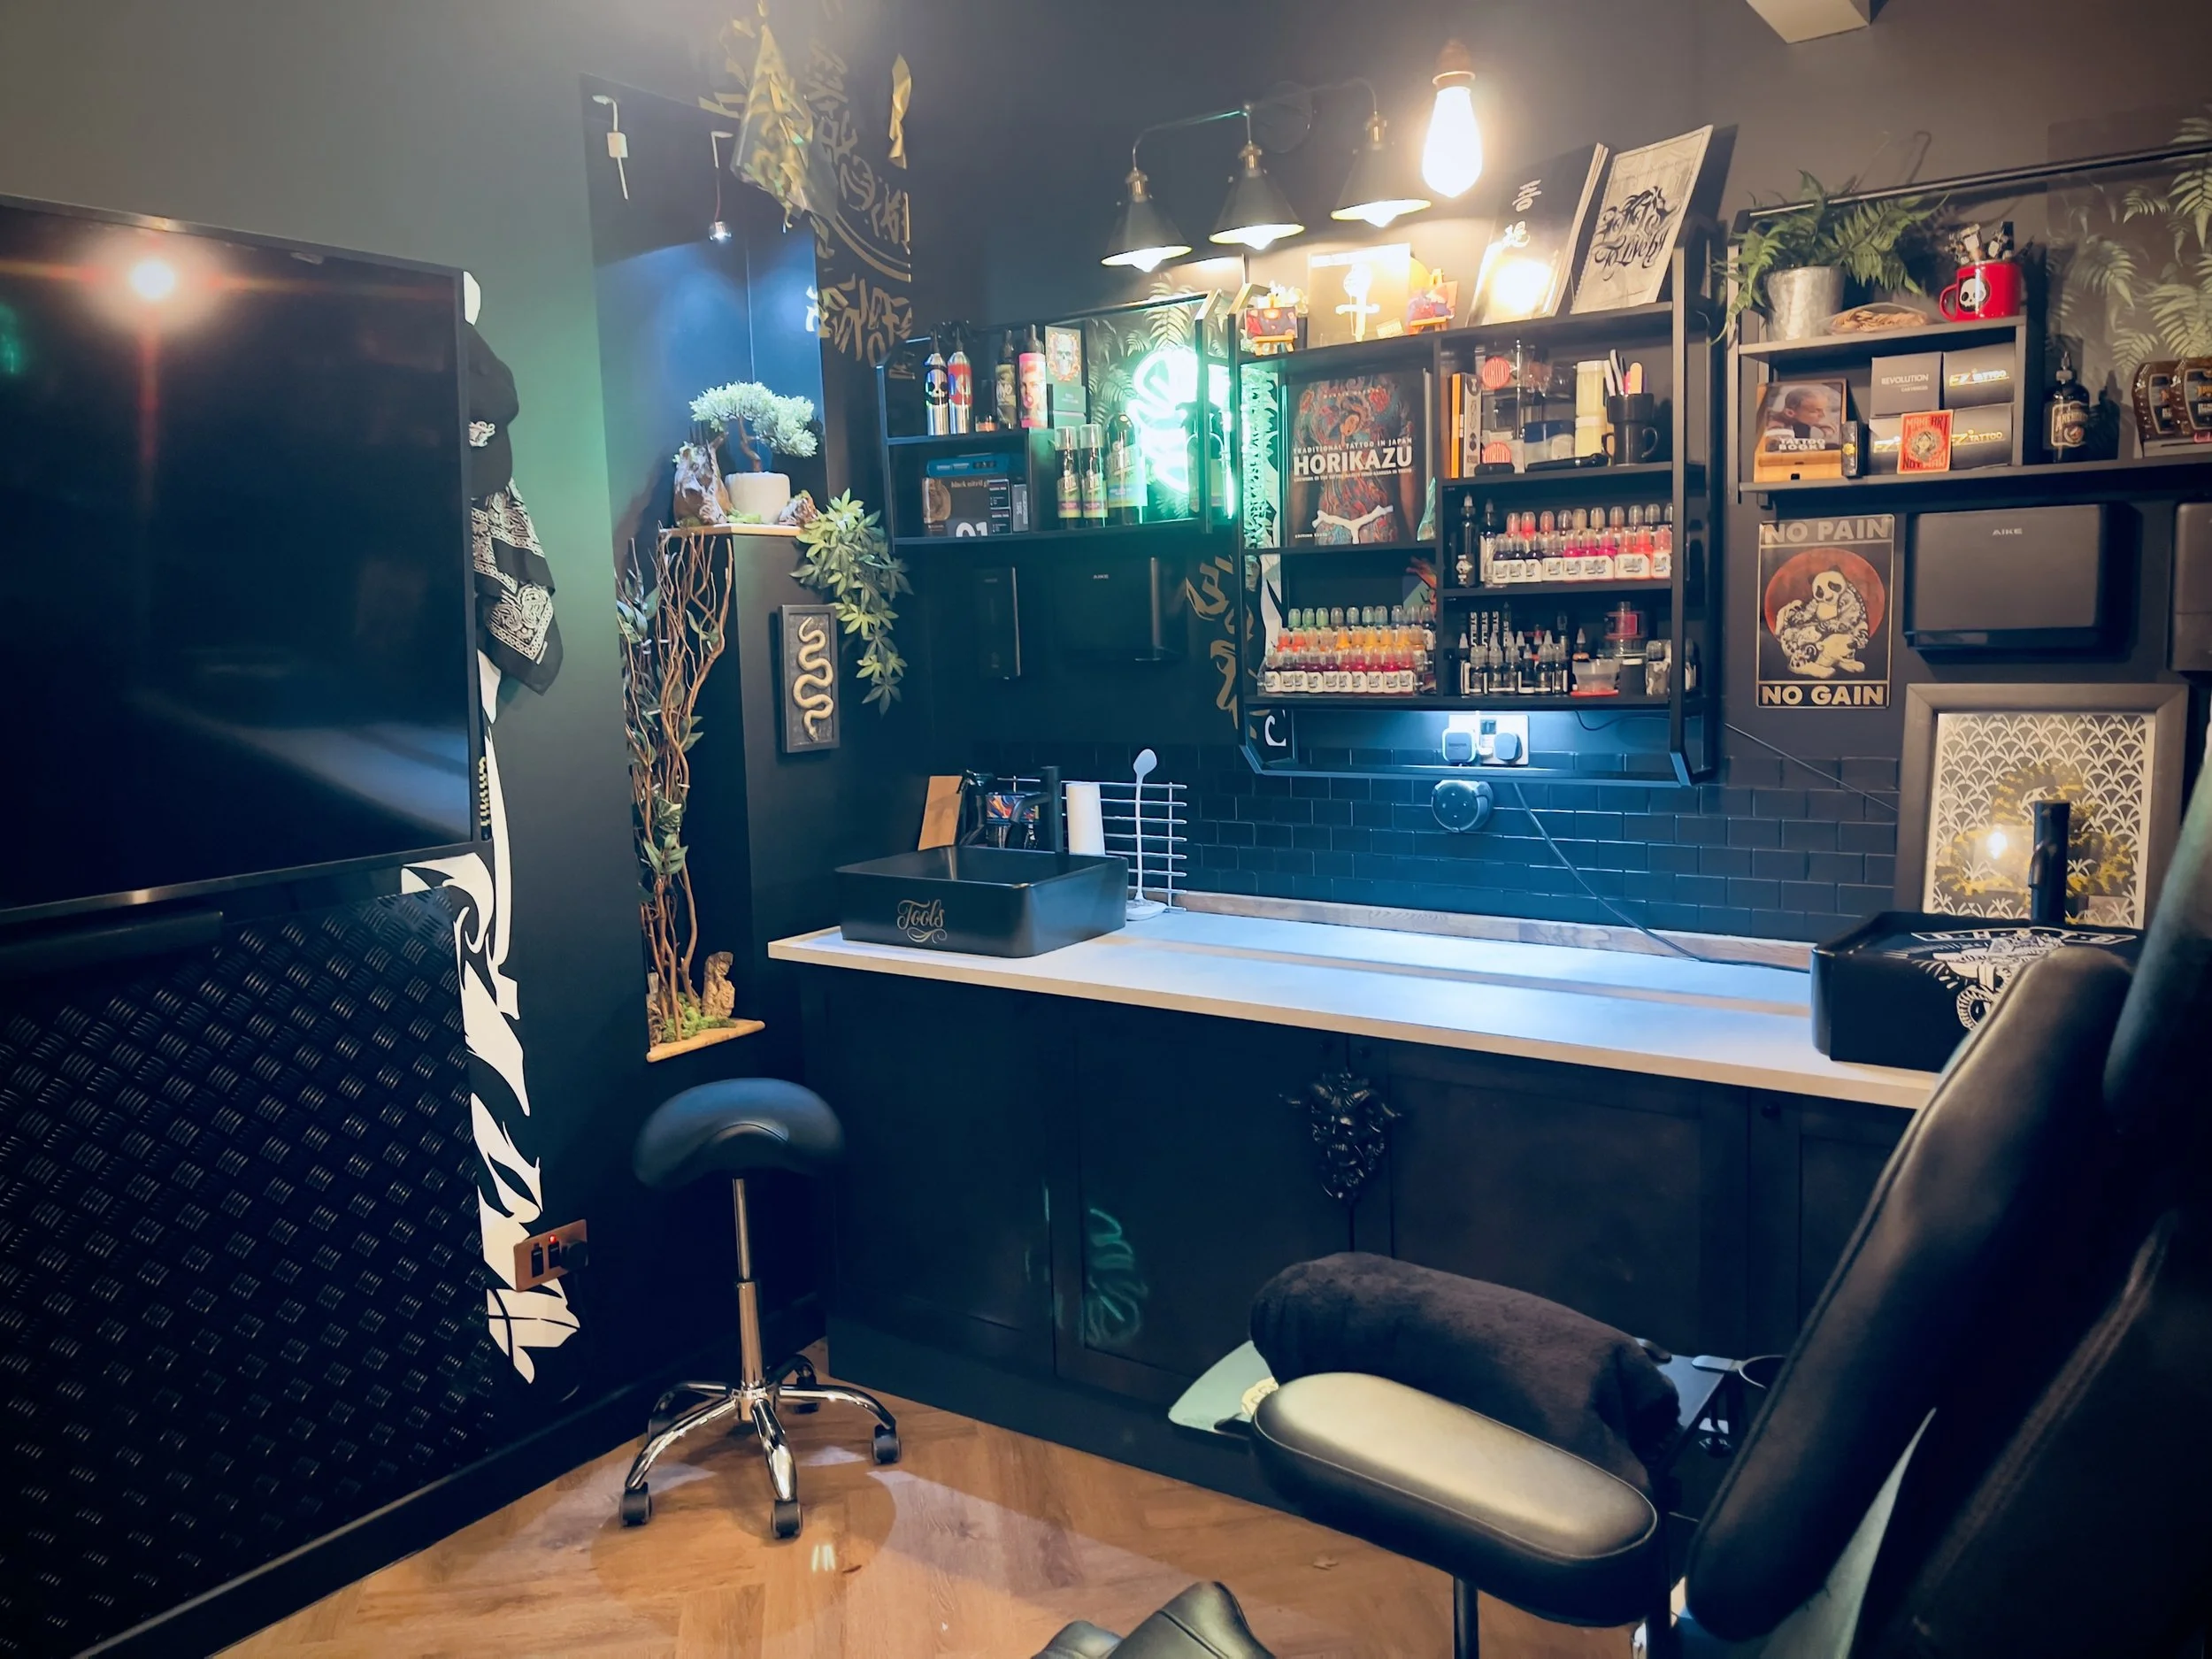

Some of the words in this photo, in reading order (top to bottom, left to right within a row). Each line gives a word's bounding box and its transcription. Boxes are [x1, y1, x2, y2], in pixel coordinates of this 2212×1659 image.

[1880, 373, 1930, 385] REVOLUTION
[1293, 444, 1342, 455] TRADITIONAL
[1345, 441, 1375, 450] TATTOO
[1388, 436, 1413, 447] JAPAN
[1778, 436, 1826, 445] TATTOO
[1970, 431, 2004, 442] TATTOO
[1293, 445, 1413, 476] HORIKAZU
[1763, 522, 1809, 544] NO
[1816, 517, 1888, 542] PAIN
[1992, 527, 2024, 536] AIKE
[1762, 685, 1803, 706] NO
[1810, 684, 1885, 706] GAIN
[896, 898, 946, 933] Tools
